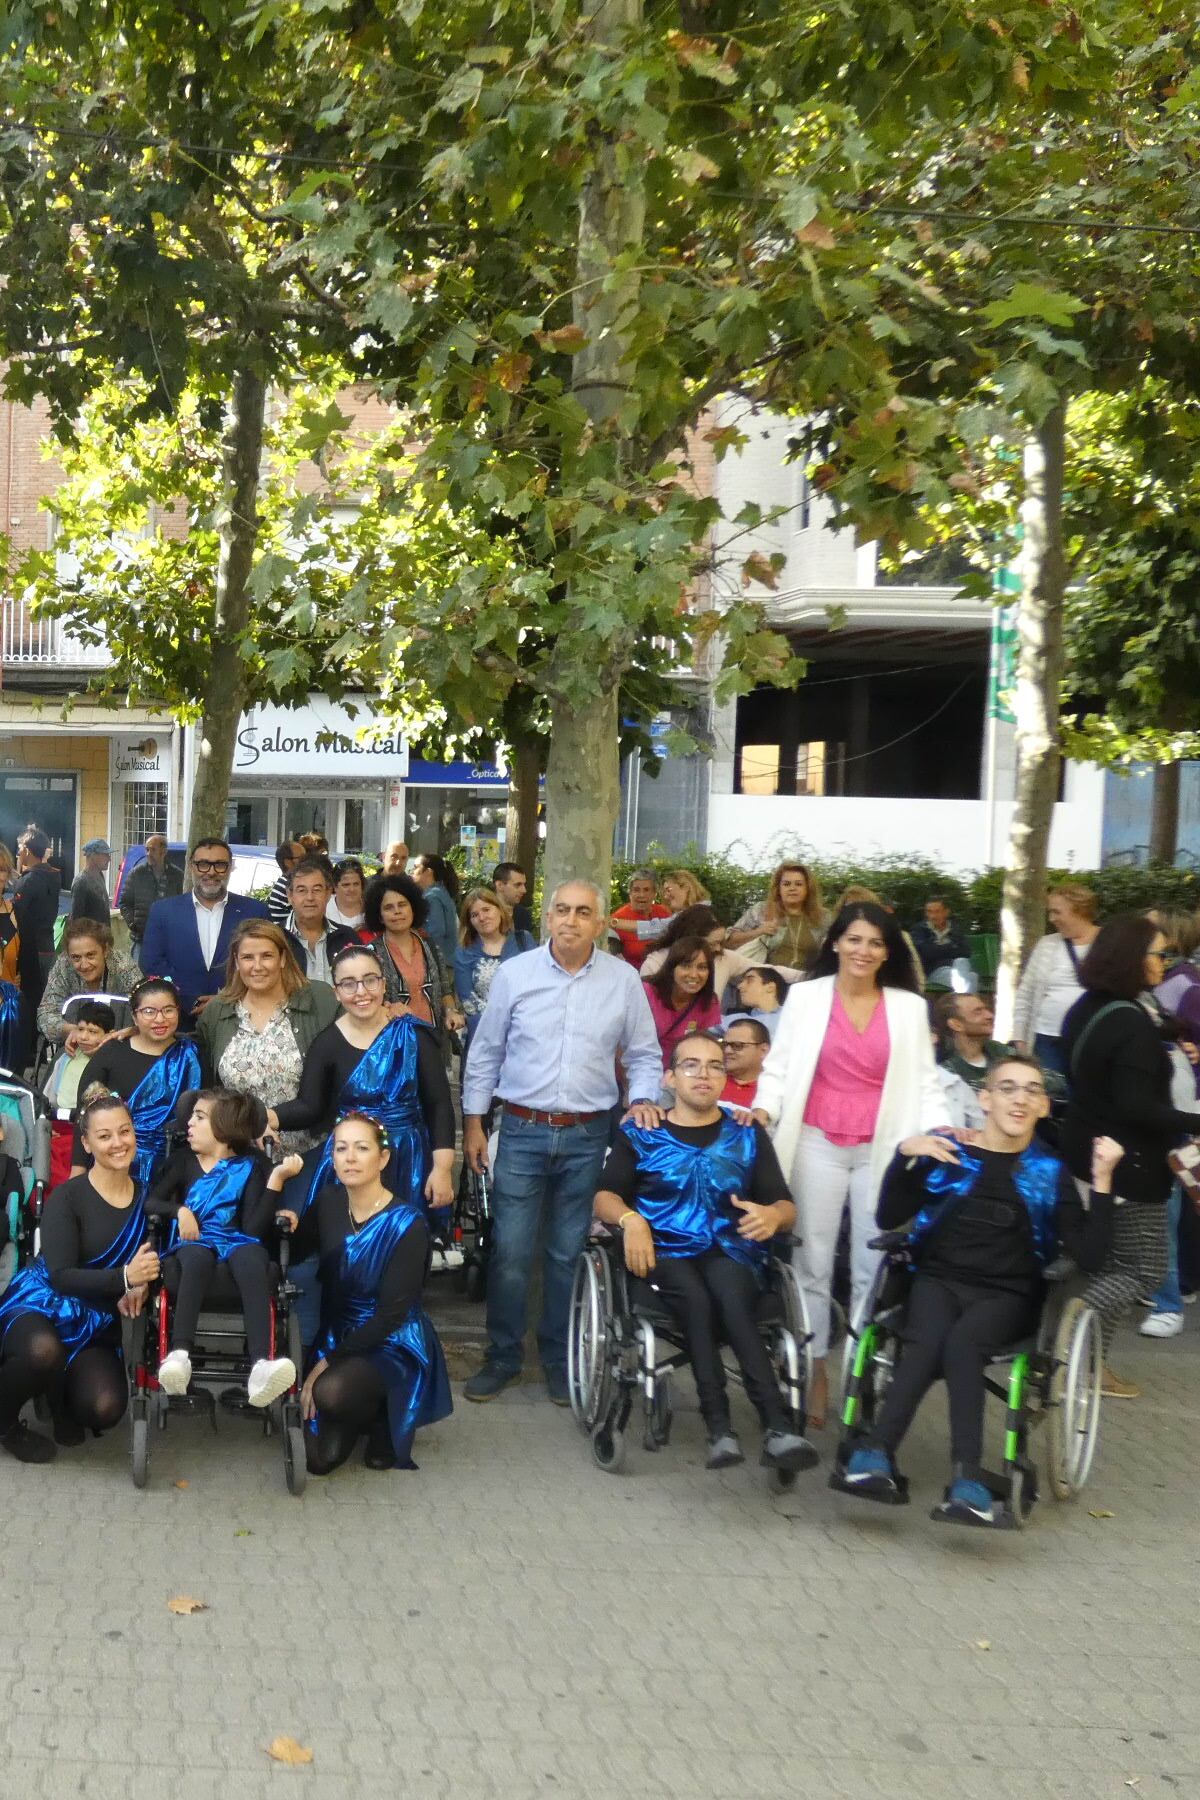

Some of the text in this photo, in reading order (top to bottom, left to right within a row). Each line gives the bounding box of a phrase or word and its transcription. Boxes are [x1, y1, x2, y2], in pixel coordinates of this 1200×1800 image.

[236, 726, 404, 767] Salon Muscal
[131, 754, 160, 771] Musical
